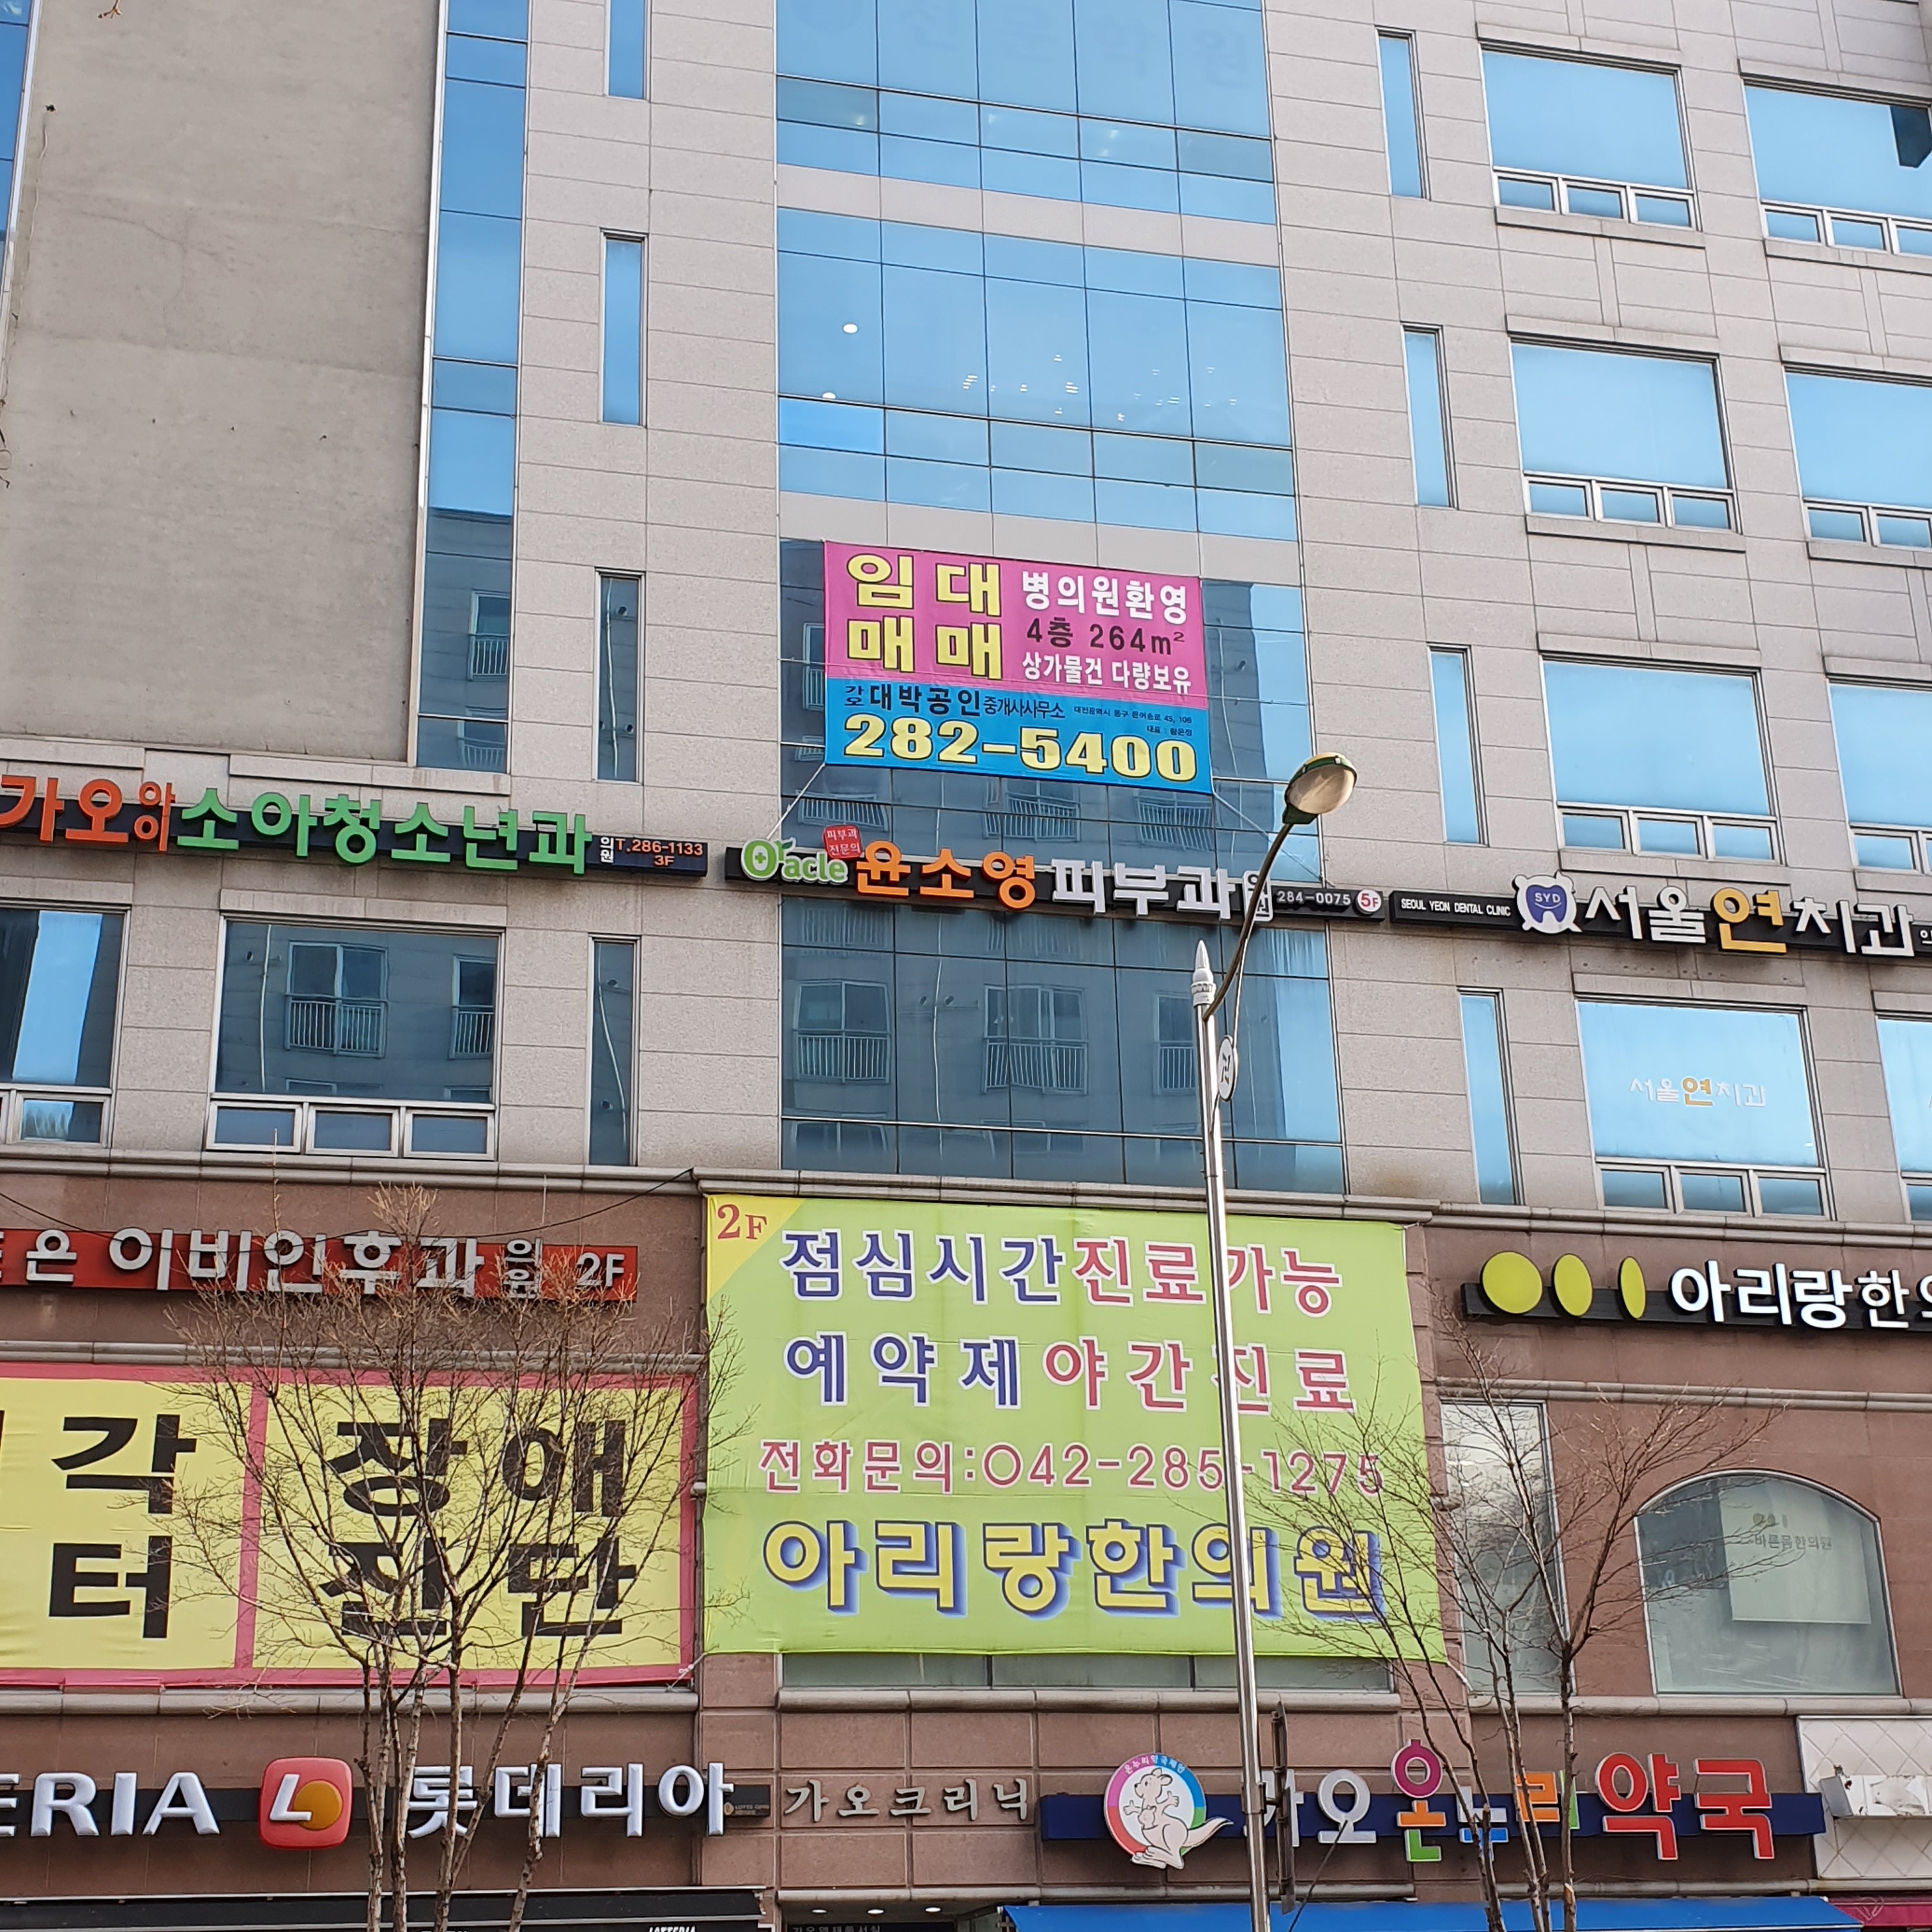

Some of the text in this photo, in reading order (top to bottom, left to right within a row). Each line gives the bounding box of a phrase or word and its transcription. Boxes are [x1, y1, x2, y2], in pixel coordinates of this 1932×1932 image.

[847, 553, 1001, 617] 임대
[1023, 571, 1187, 624] 병의원환영
[847, 616, 1002, 680] 매매
[1027, 617, 1073, 648] 4층
[1022, 652, 1192, 695] 상가물건 다량보유
[843, 712, 1197, 783] 282-5400
[654, 855, 675, 868] 3F
[742, 838, 848, 885] Oracle
[1277, 891, 1351, 905] 284-0075
[1360, 893, 1379, 908] 5F
[1401, 898, 1511, 916] SEOUL YEON DENTAL CLINIC
[1535, 893, 1561, 903] SYD
[717, 1204, 768, 1241] 2F
[577, 1252, 625, 1287] 2F
[327, 1418, 625, 1517] 장애
[408, 1763, 734, 1837] 롯데리아
